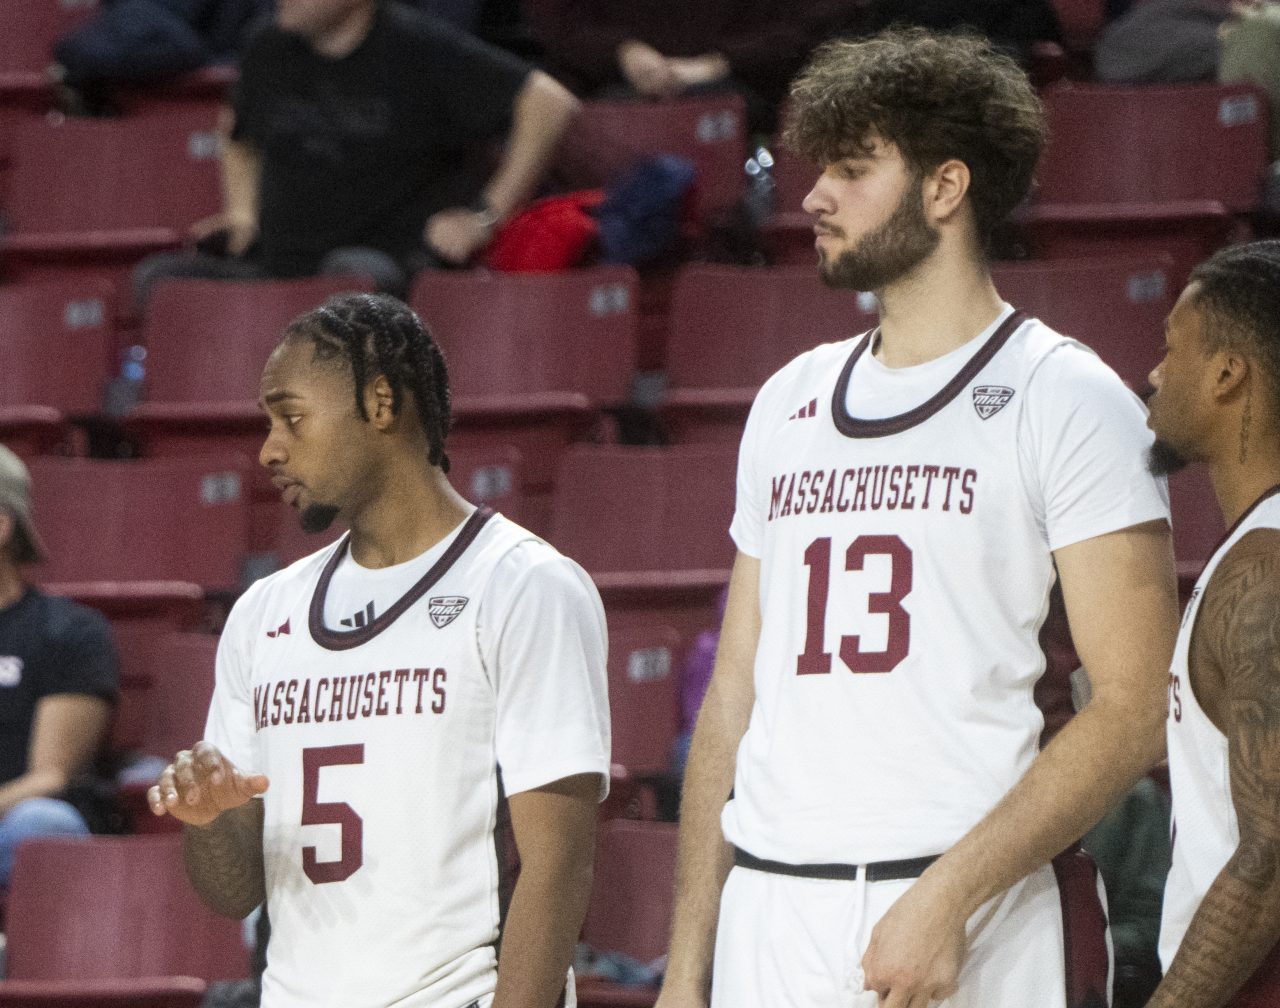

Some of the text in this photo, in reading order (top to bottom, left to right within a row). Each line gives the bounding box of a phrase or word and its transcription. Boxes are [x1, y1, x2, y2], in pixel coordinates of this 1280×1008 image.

[768, 465, 977, 521] MASSACHUSETTS
[797, 535, 913, 675] 13
[301, 743, 364, 884] 5
